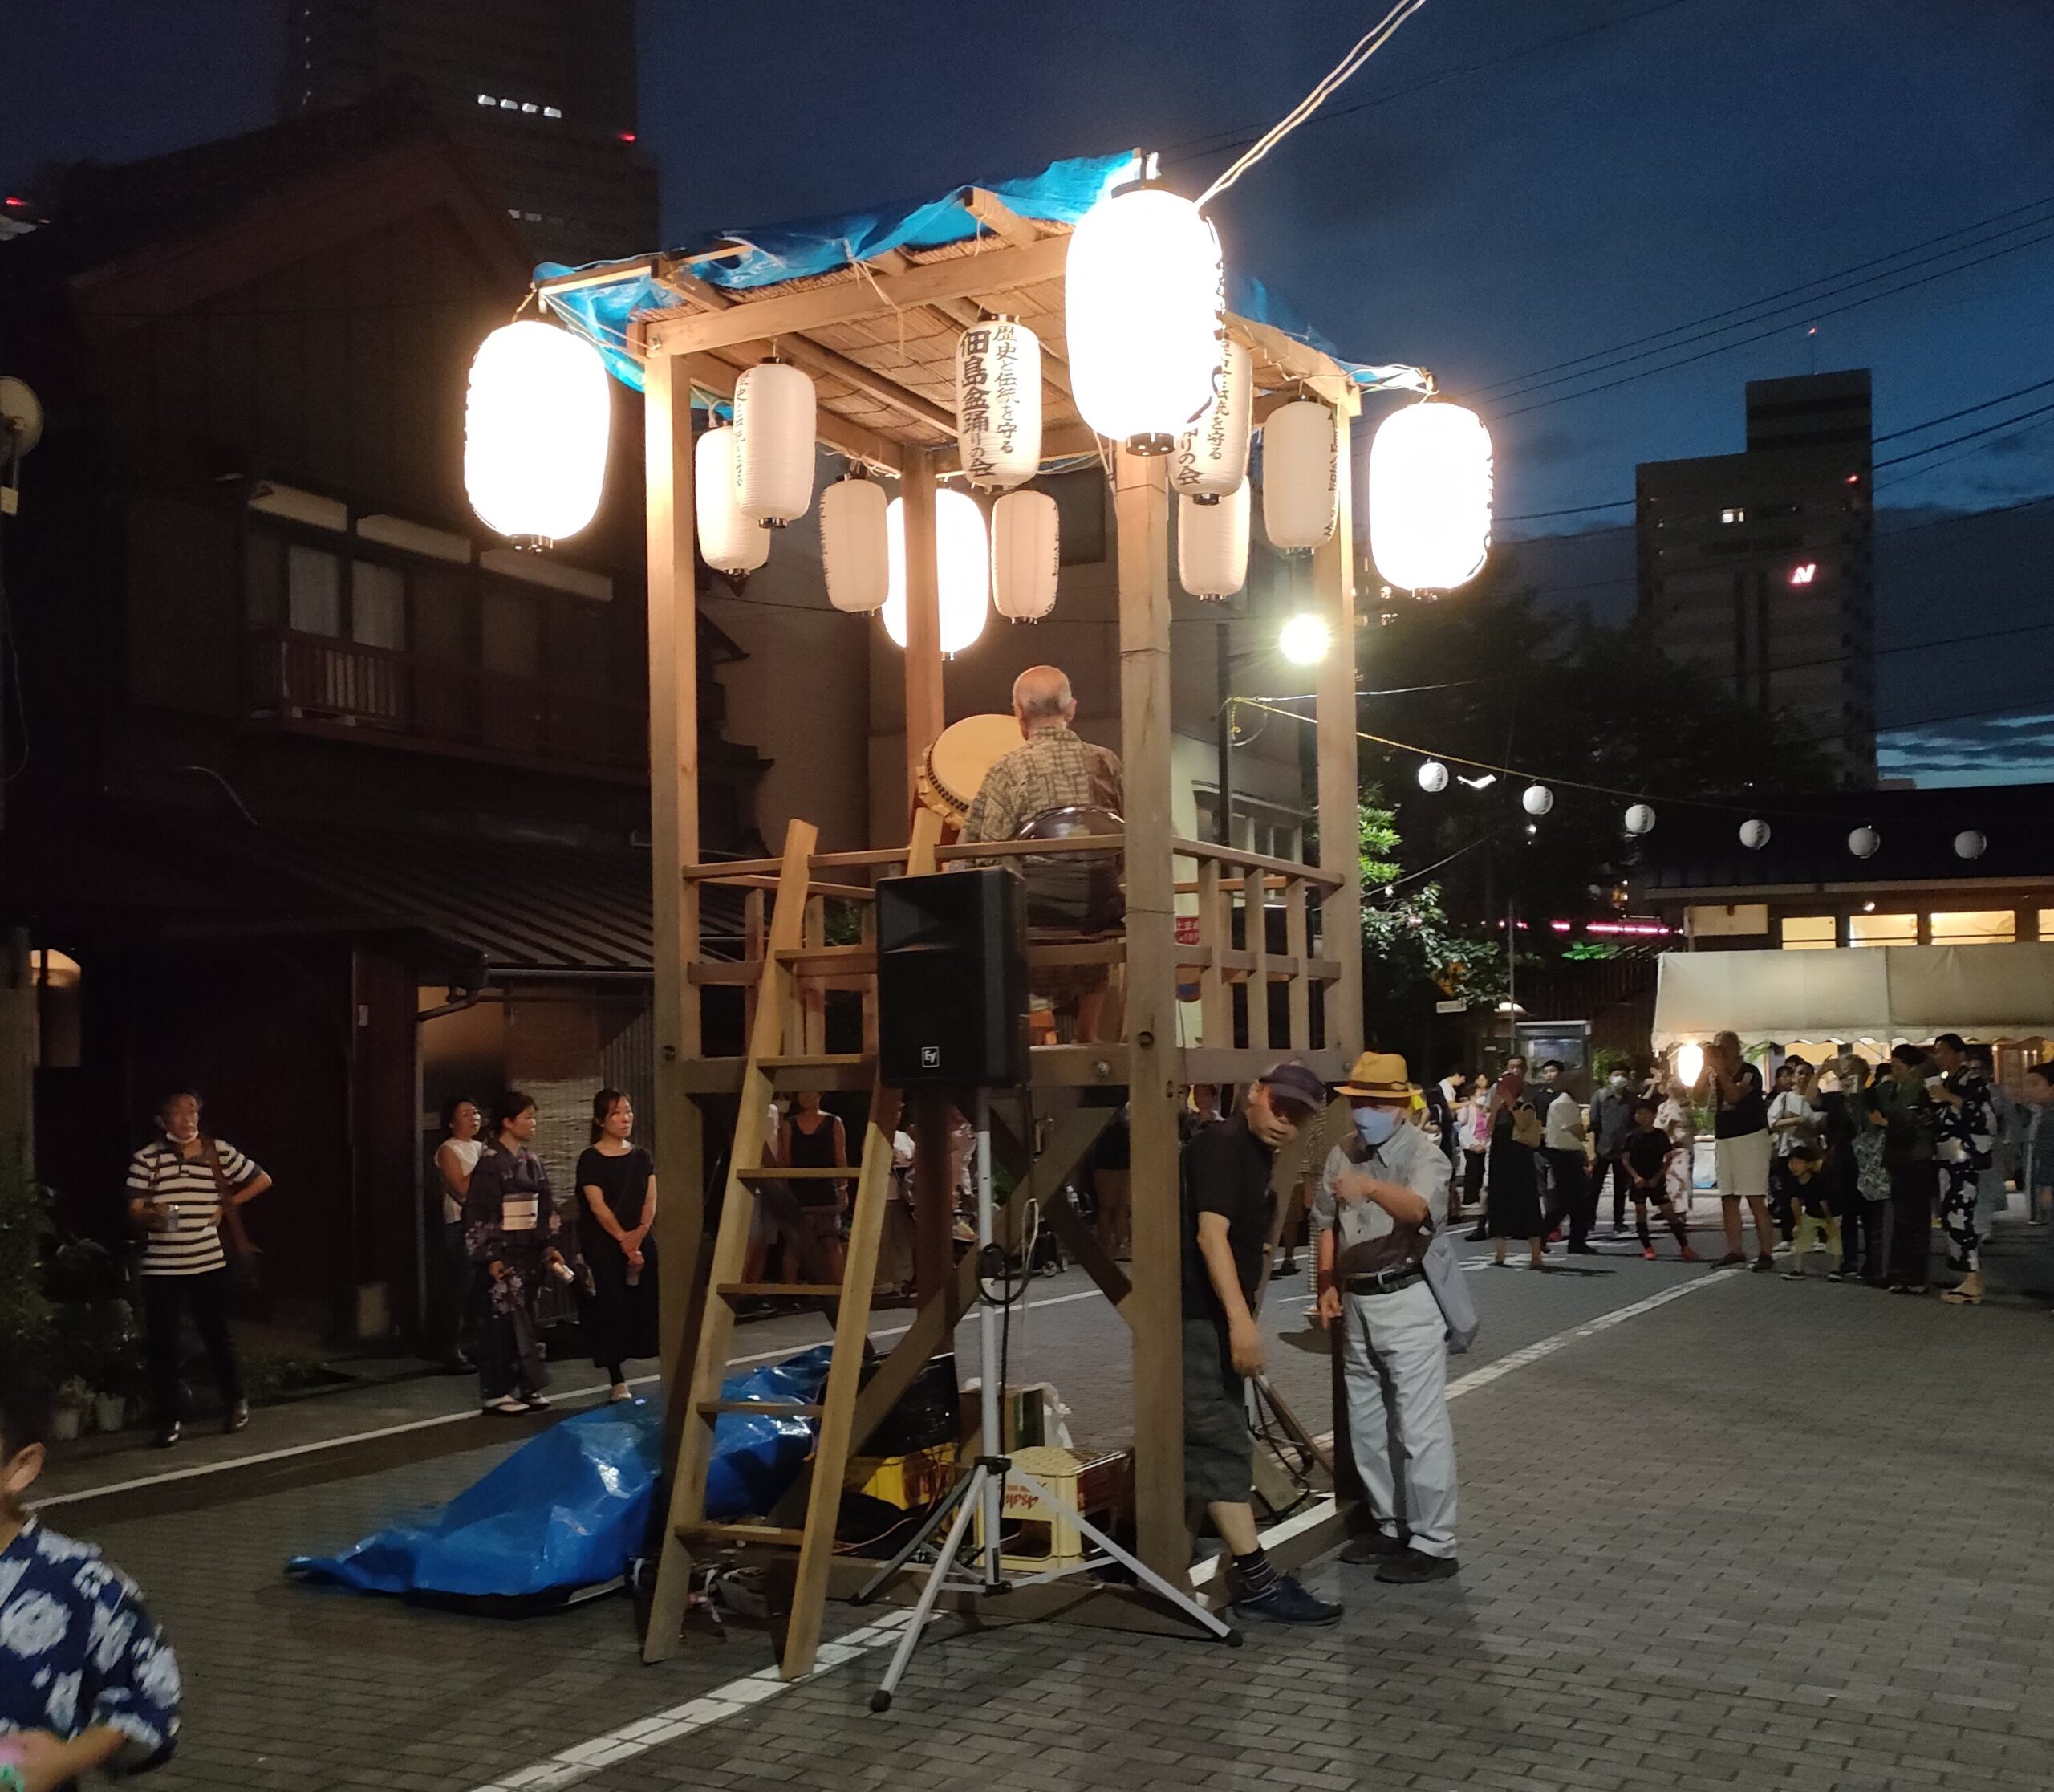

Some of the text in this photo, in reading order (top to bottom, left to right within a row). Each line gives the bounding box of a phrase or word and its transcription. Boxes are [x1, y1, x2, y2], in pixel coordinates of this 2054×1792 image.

[960, 329, 996, 477] 佃島盆踊りの会
[992, 325, 1020, 455] 歴史と伝統を守る
[1005, 1494, 1039, 1510] Asah
